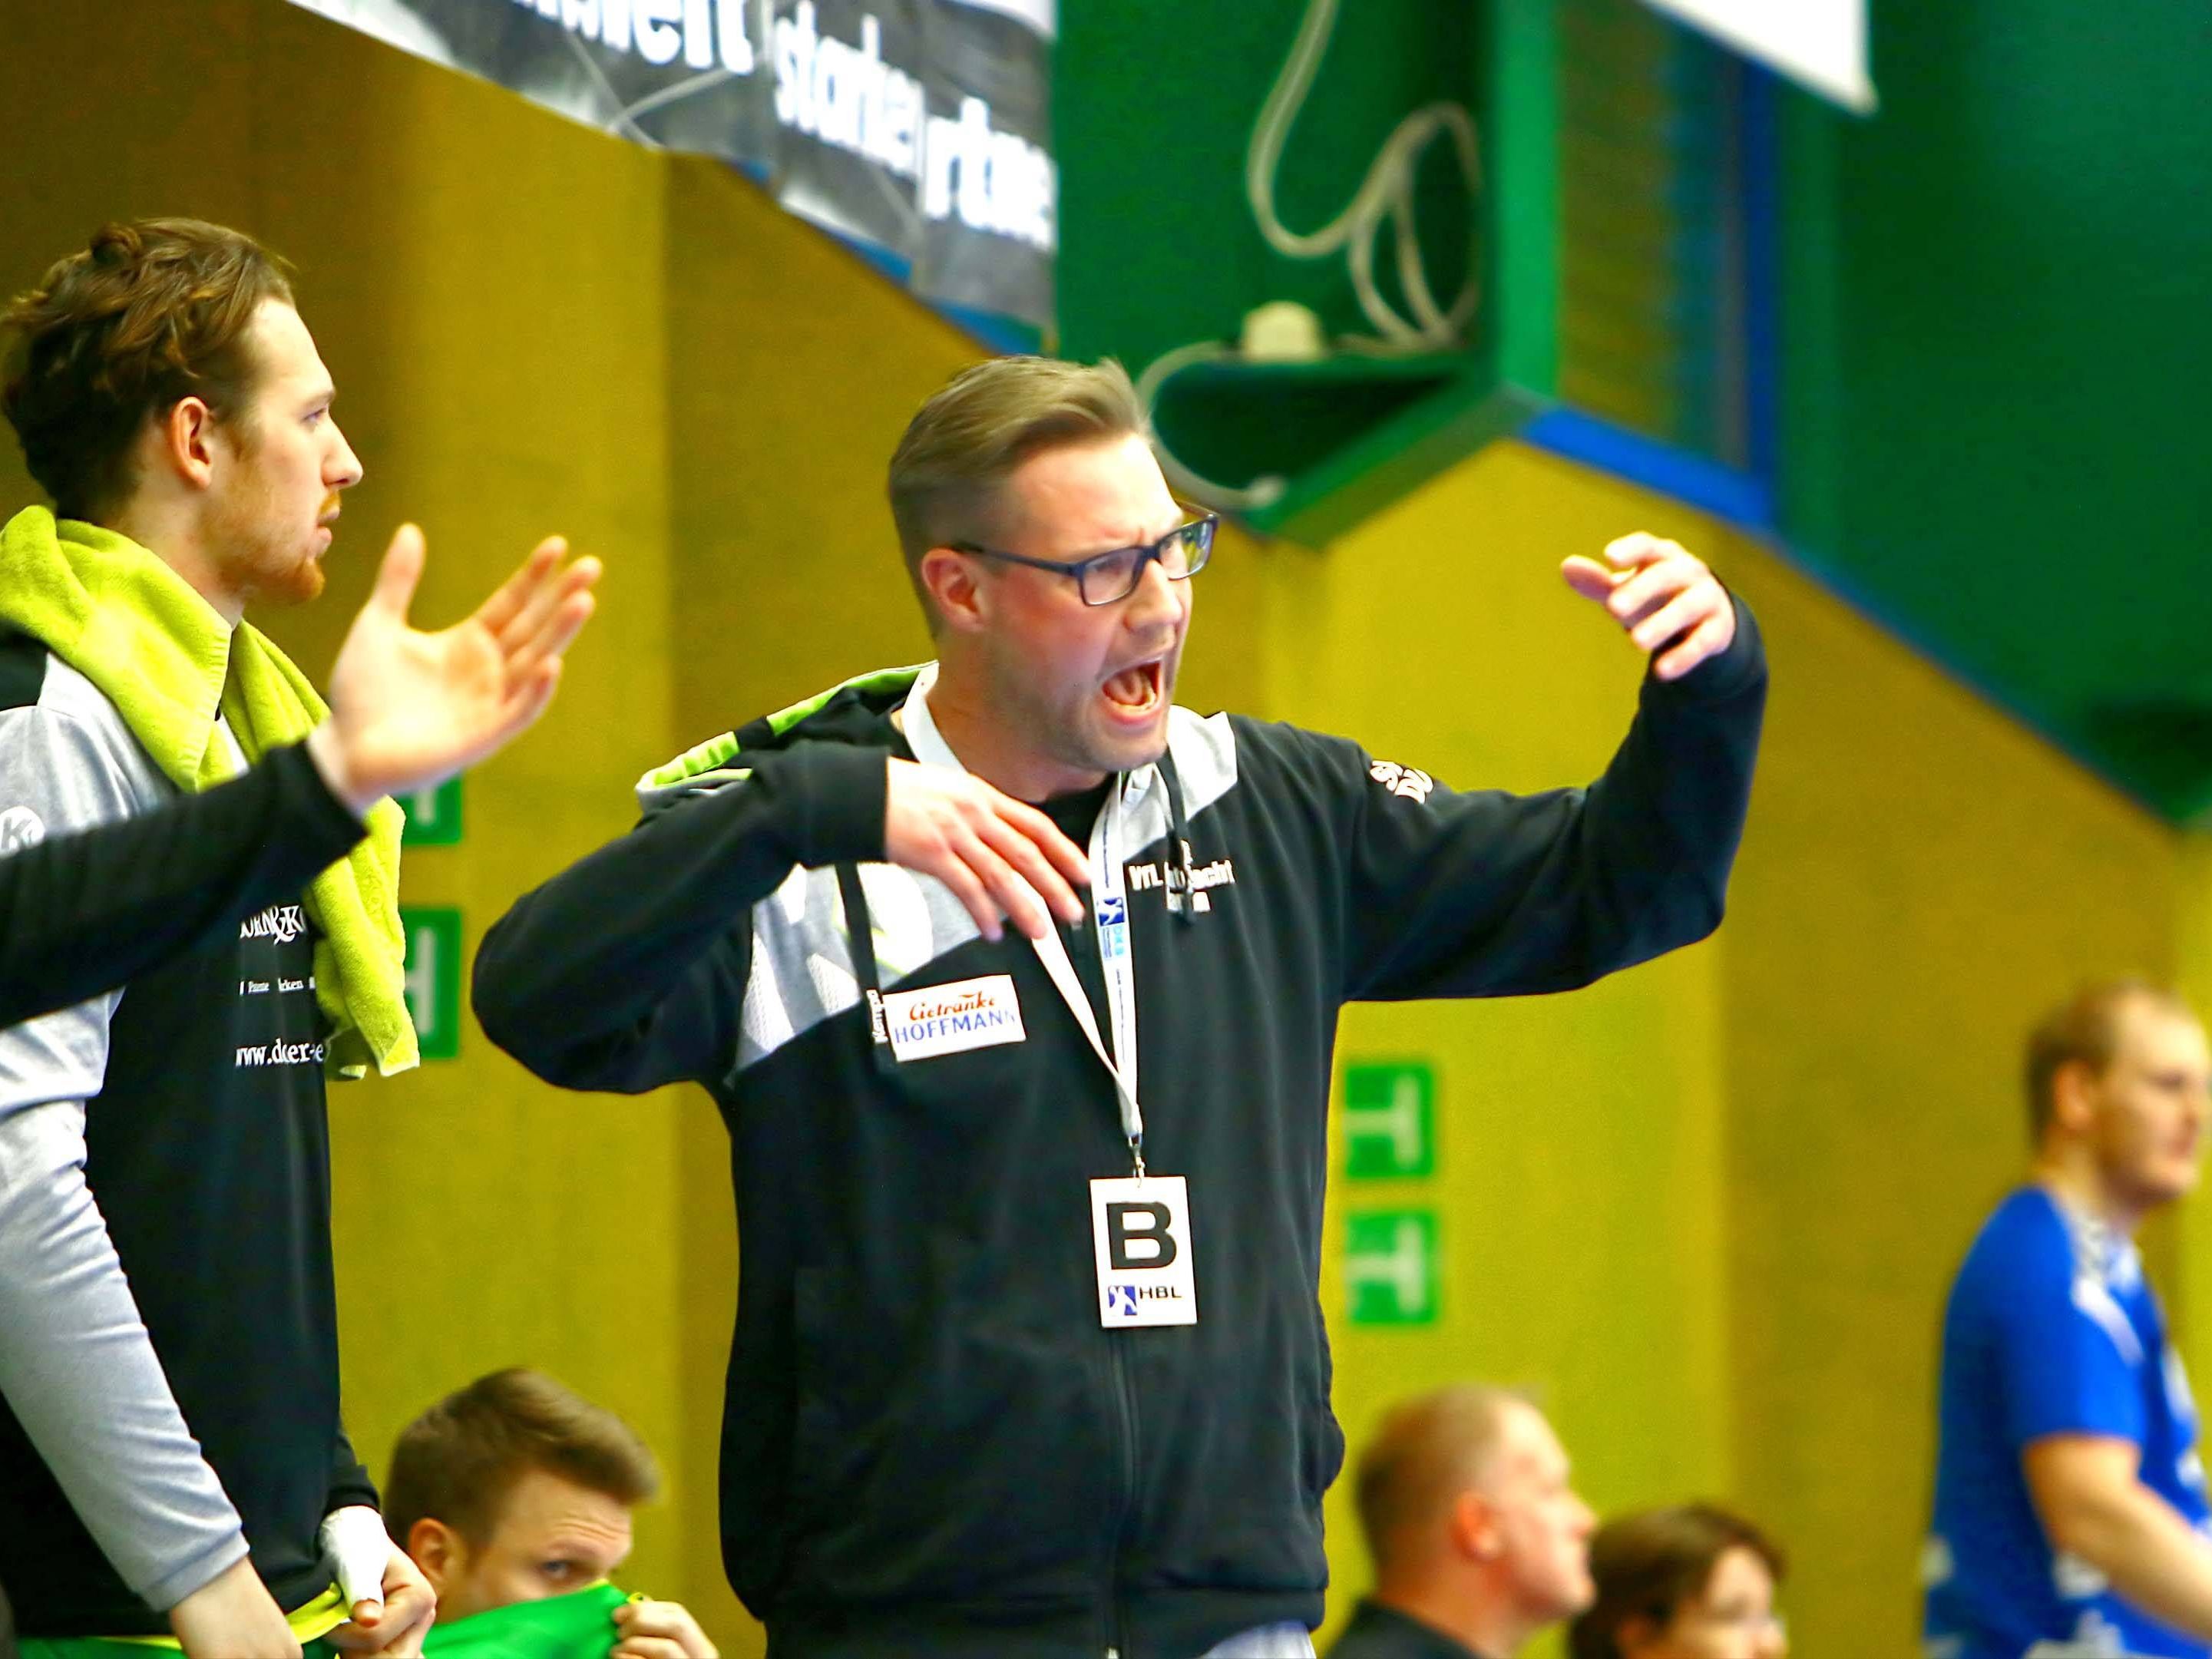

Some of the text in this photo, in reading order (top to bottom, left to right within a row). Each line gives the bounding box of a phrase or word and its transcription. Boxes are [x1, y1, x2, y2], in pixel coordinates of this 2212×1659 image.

[894, 1010, 1016, 1043] HOFFMANN
[1106, 1201, 1177, 1271] B
[1139, 1286, 1182, 1299] HBL
